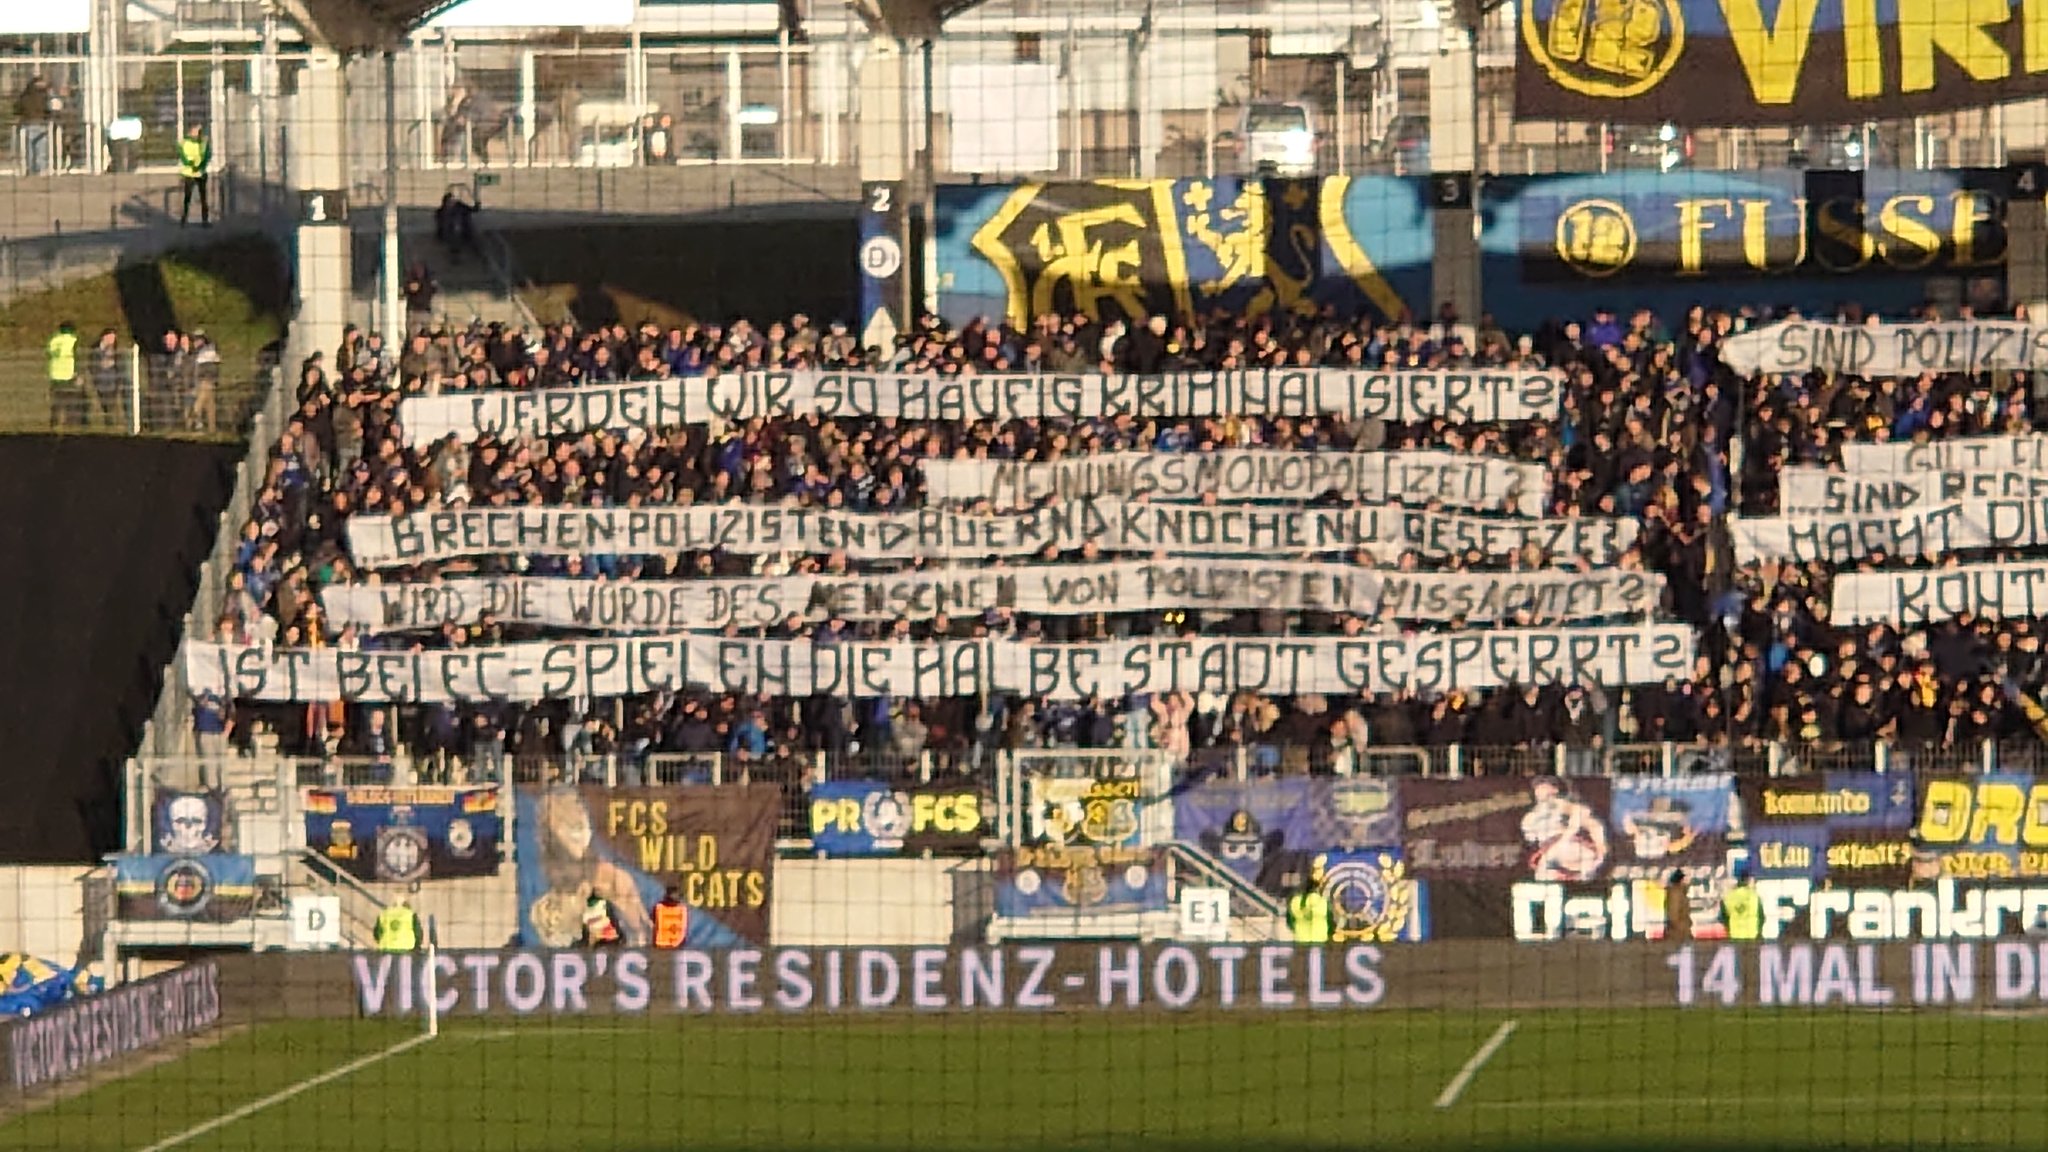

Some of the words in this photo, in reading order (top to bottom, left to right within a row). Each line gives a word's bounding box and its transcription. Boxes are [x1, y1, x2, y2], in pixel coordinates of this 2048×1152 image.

[873, 187, 890, 212] 2
[1443, 180, 1458, 202] 3
[2017, 171, 2034, 192] 4
[312, 195, 326, 221] 1
[1777, 324, 1874, 369] SIND
[472, 380, 685, 435] WERDEN
[707, 372, 793, 417] WIR
[814, 376, 877, 416] SO
[1788, 503, 1964, 563] MACHT
[1987, 499, 2048, 547] DI
[485, 581, 544, 620] DIE
[706, 583, 783, 622] DES
[1043, 566, 1121, 605] VON
[219, 646, 310, 700] IST
[337, 650, 421, 701] BEI
[811, 643, 893, 698] DIE
[914, 641, 1100, 697] HALBE
[1123, 641, 1314, 694] STADT
[1336, 633, 1686, 690] GESPERRT?
[608, 800, 667, 838] FCS
[912, 794, 981, 832] FCS
[640, 835, 715, 872] WILD
[686, 872, 765, 908] CATS
[309, 909, 326, 931] D
[1190, 900, 1220, 923] E1
[354, 952, 652, 1013] VICTOR'S
[674, 946, 1387, 1010] RESIDENZ-HOTELS
[1666, 944, 1742, 1005] 14
[1758, 944, 1896, 1004] MAL
[1912, 943, 1975, 1002] IN
